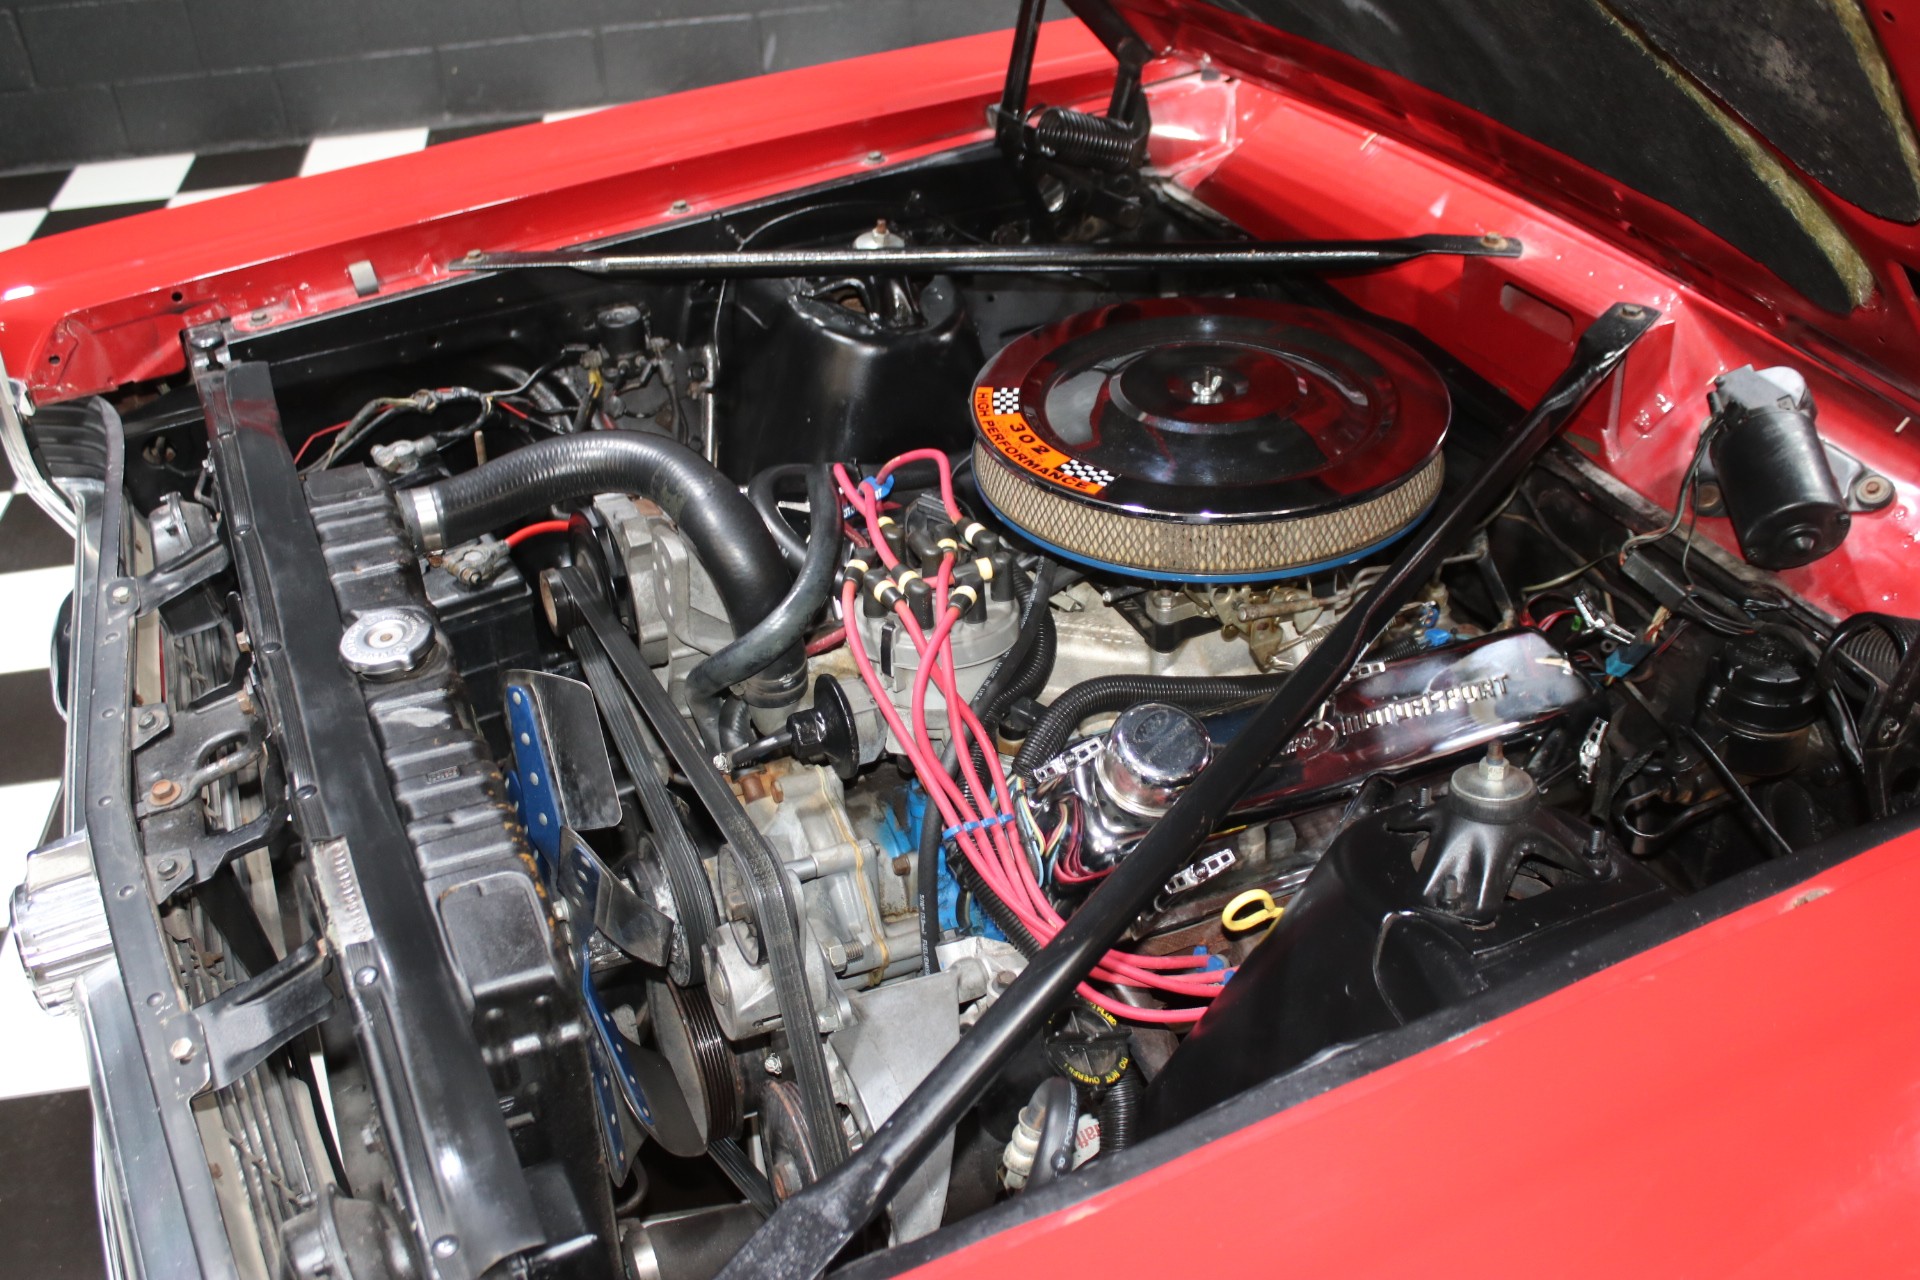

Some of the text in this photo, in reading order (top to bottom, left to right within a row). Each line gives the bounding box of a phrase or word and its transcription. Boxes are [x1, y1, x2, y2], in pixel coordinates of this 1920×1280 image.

[976, 391, 990, 418] HIGH
[983, 420, 1090, 490] PERFORMANCE
[1009, 422, 1051, 456] 302
[1063, 1104, 1078, 1146] POWER
